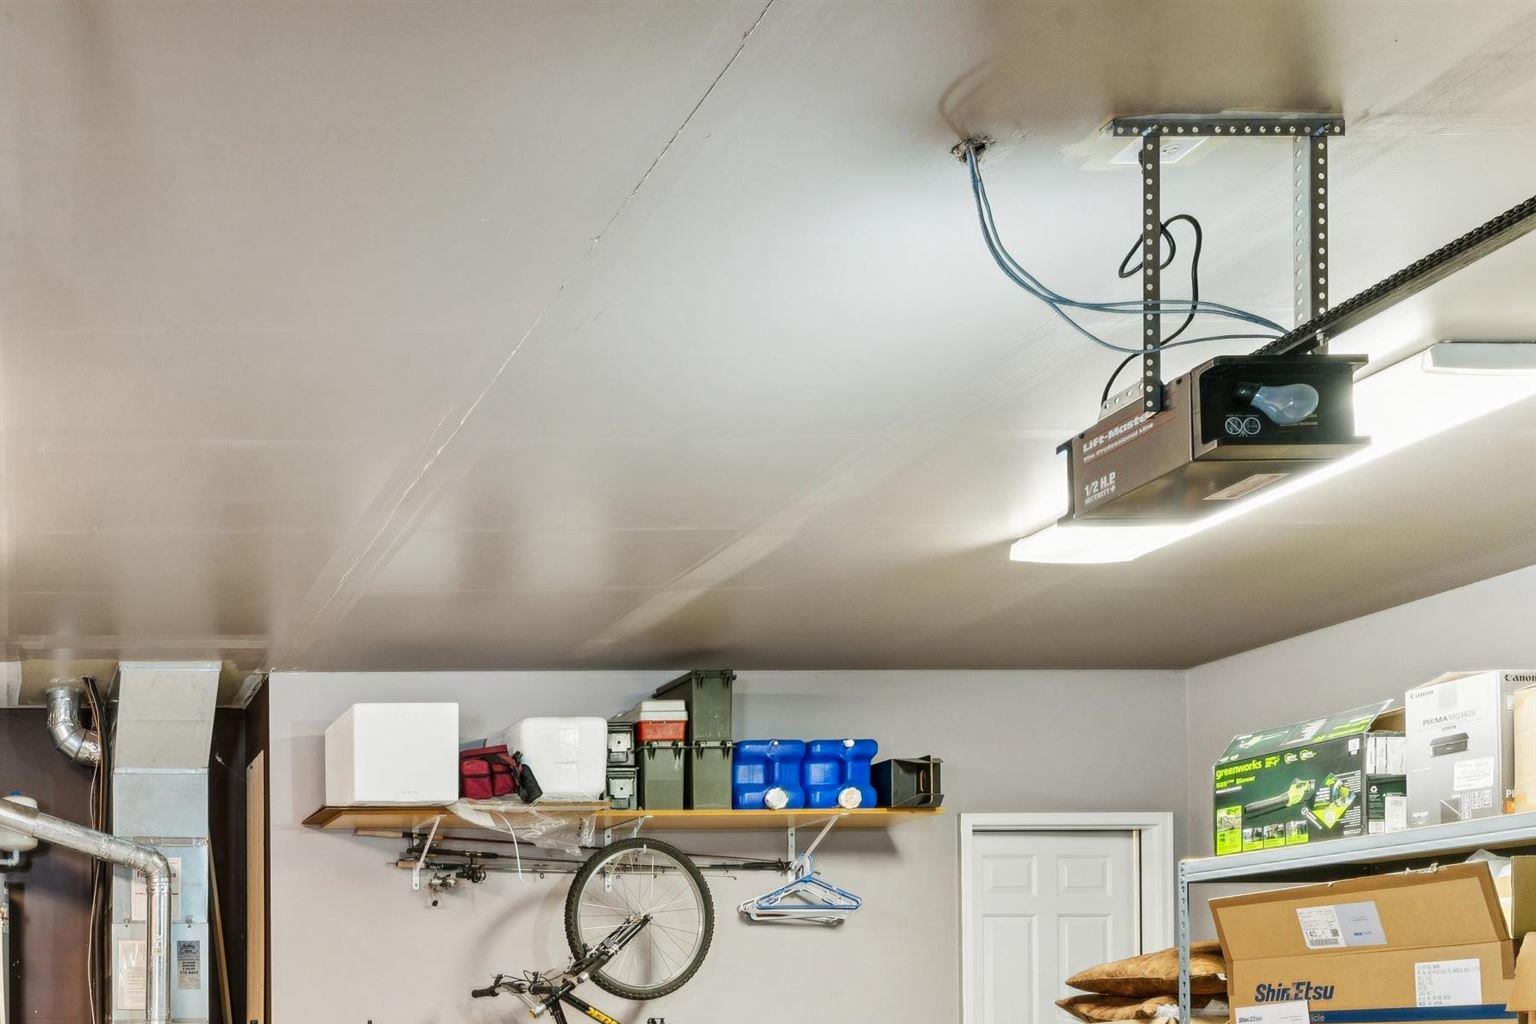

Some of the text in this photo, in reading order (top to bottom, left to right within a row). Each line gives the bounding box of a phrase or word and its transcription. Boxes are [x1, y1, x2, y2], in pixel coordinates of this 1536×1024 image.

[1083, 412, 1148, 453] Lift-Maste
[1504, 673, 1536, 682] Canon
[1409, 690, 1434, 699] Canon
[1422, 715, 1448, 727] PIXMA
[1216, 759, 1262, 780] greenworks
